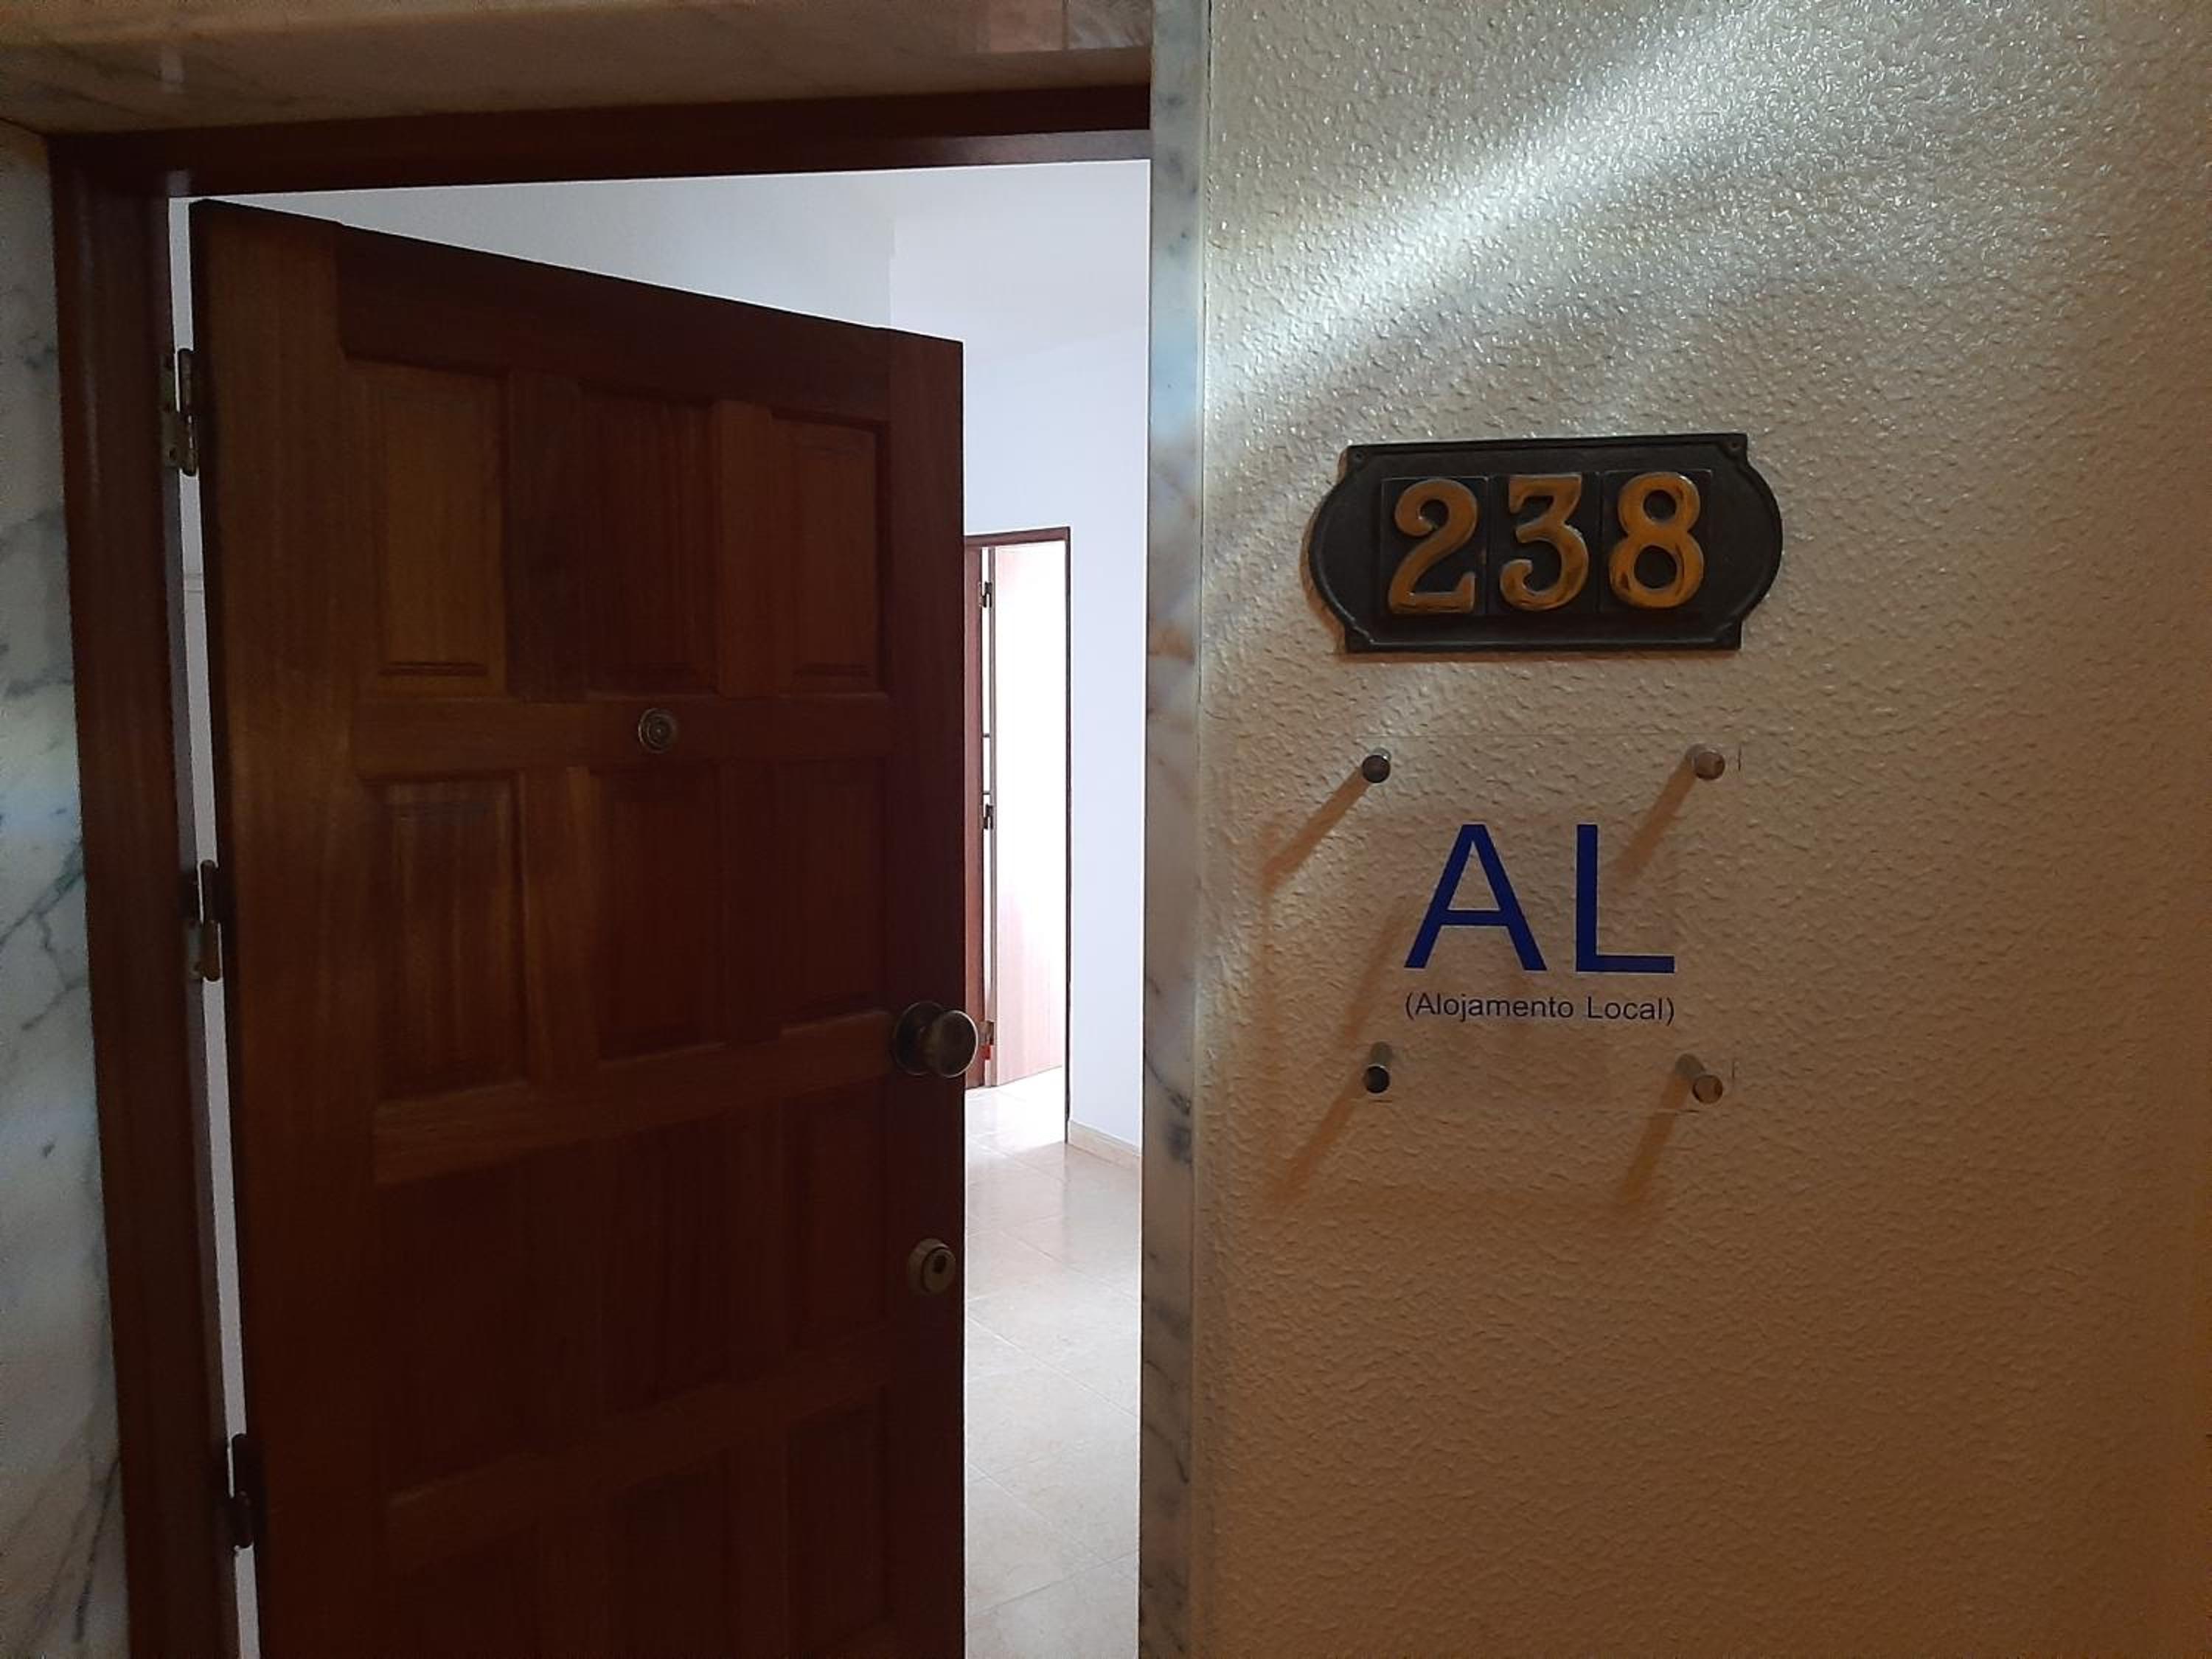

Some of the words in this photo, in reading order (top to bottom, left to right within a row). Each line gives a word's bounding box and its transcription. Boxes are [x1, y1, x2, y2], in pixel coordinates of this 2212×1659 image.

[1387, 472, 1705, 613] 238
[1404, 824, 1675, 973] AL
[1405, 992, 1574, 1022] (Alojamento
[1587, 996, 1675, 1025] Local)
